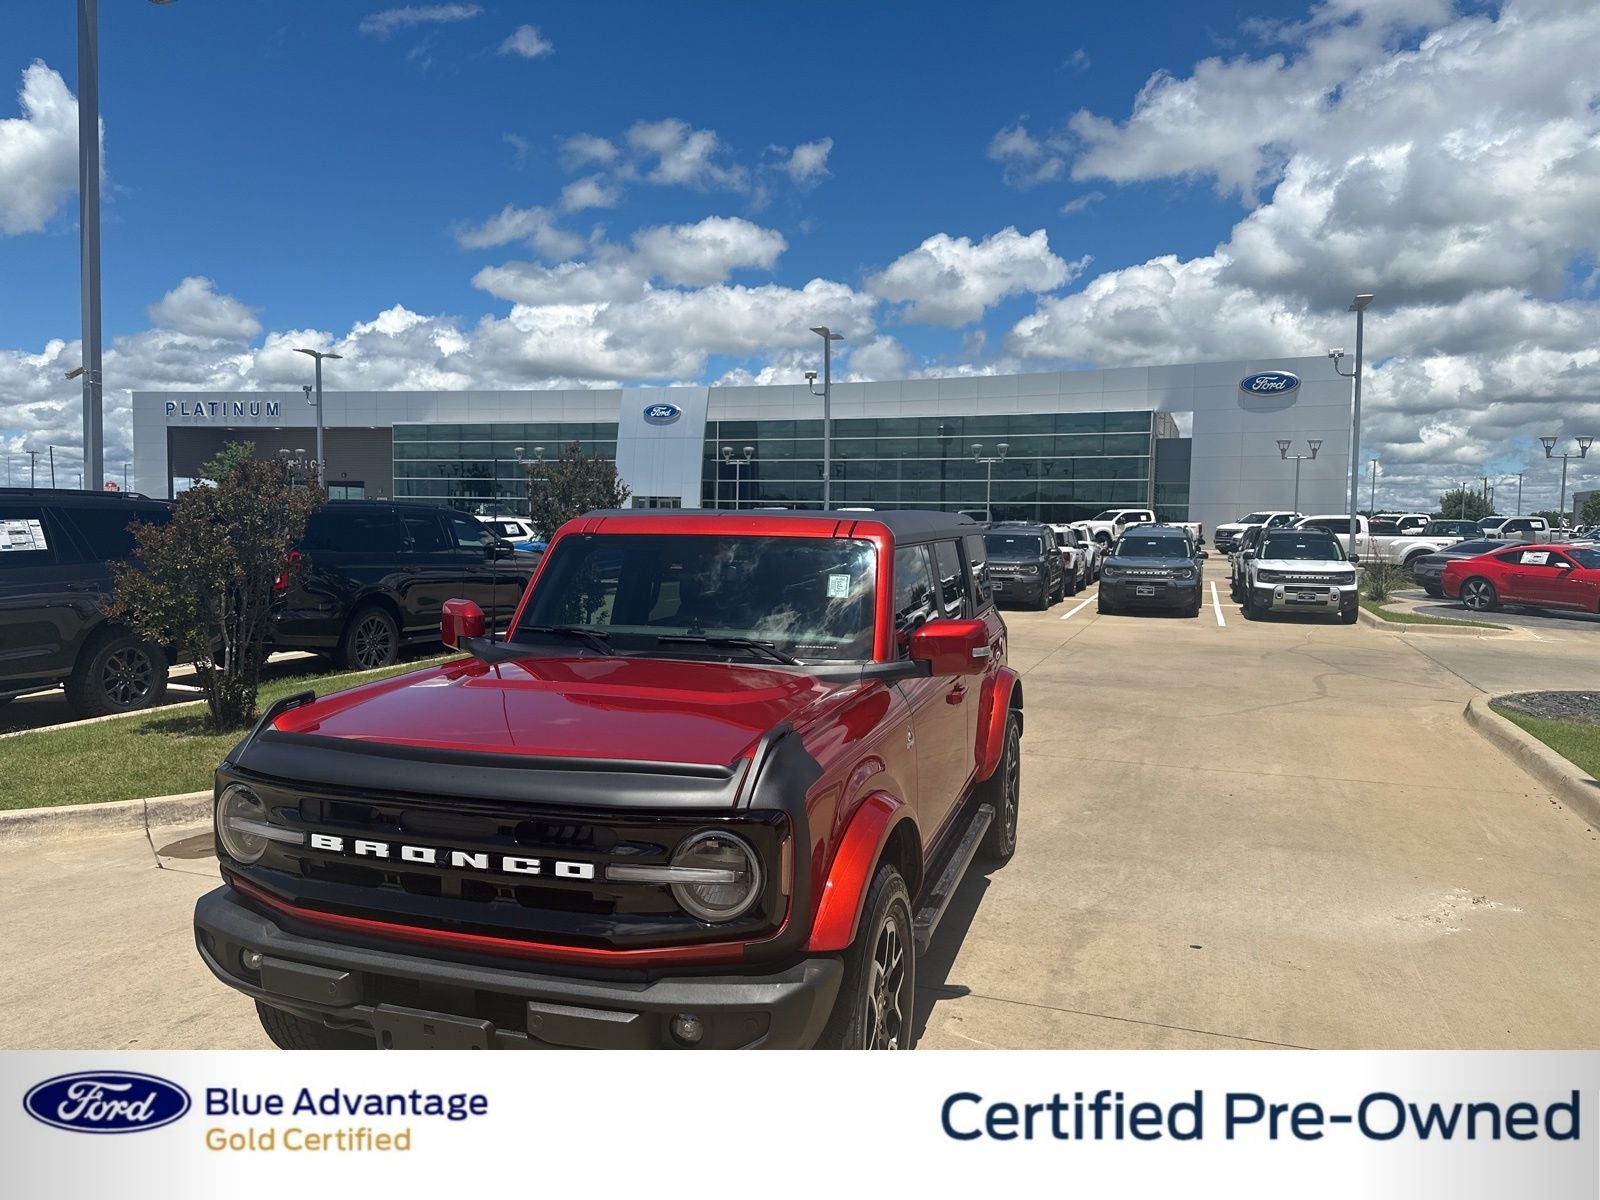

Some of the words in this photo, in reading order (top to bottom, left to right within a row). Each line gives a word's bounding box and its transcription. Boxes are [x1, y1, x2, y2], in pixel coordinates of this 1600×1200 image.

[1252, 376, 1287, 390] Ford
[165, 401, 280, 417] PLATINUM
[650, 406, 672, 417] Ford
[311, 832, 595, 879] BRONCO
